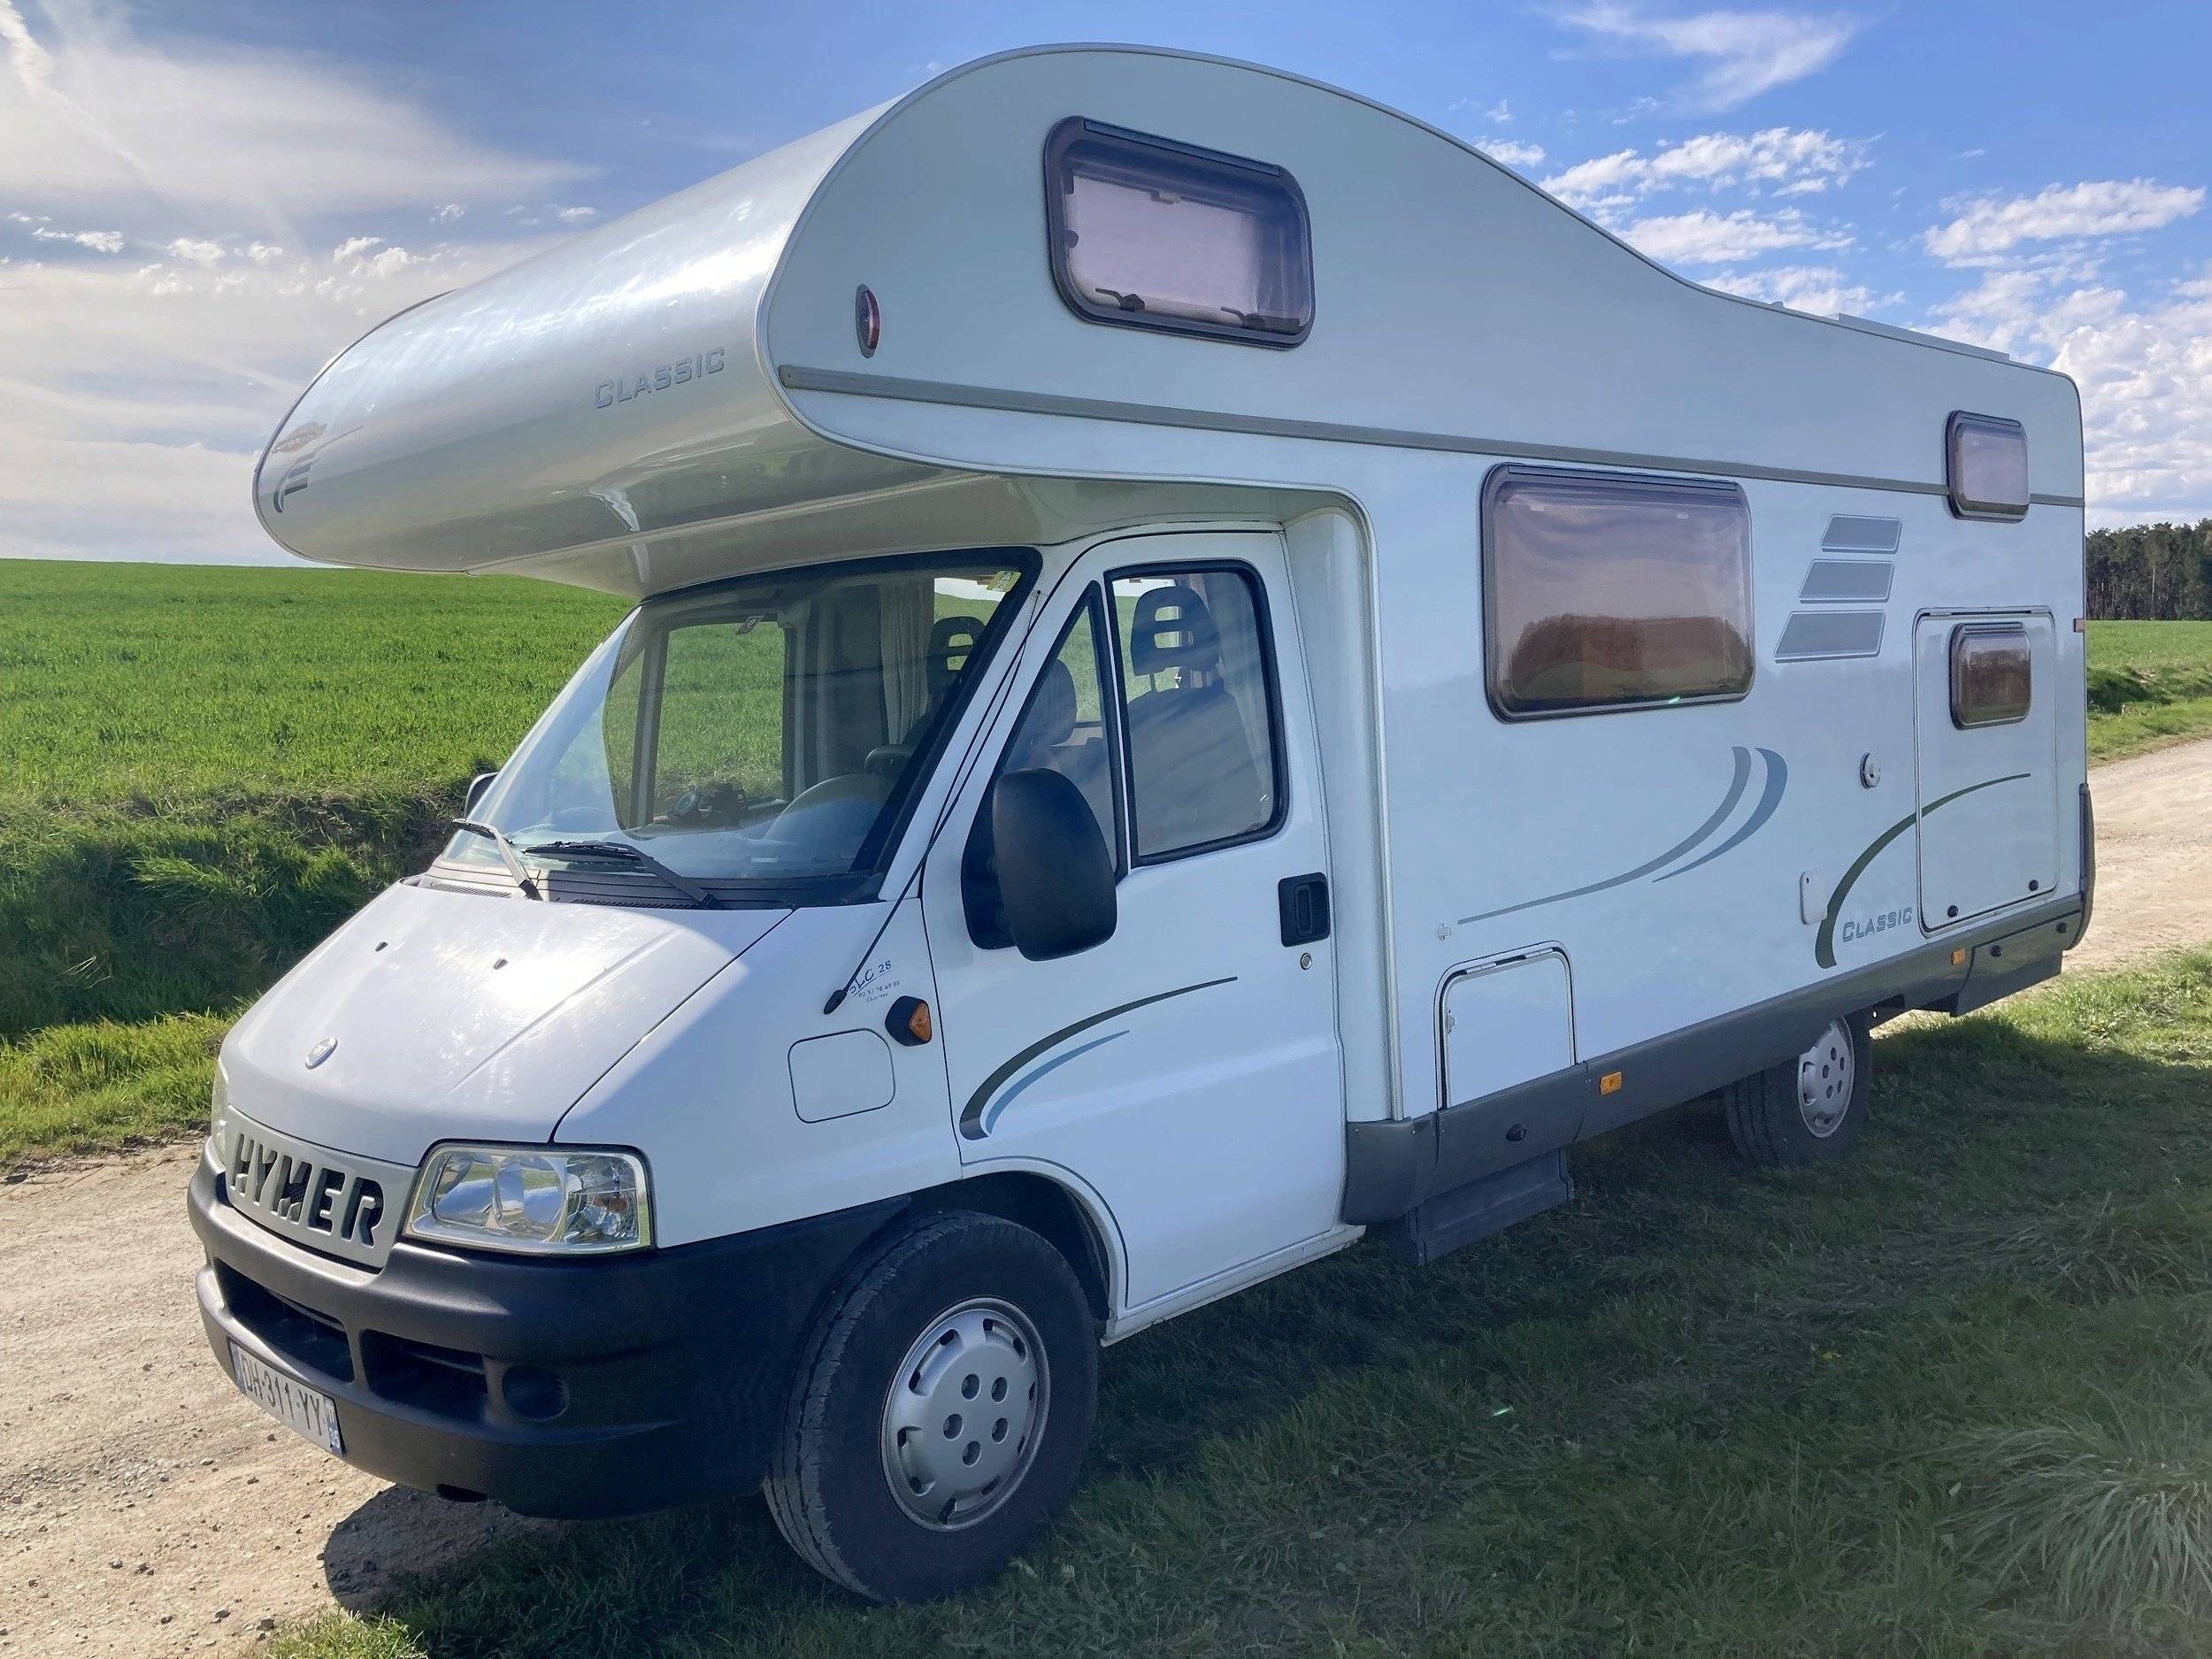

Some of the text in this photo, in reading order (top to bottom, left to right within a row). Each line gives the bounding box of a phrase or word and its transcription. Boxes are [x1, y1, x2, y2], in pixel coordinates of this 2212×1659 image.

[595, 346, 726, 409] CLASSIC
[1842, 907, 1913, 942] CLASSIC
[230, 1133, 384, 1248] HYMER
